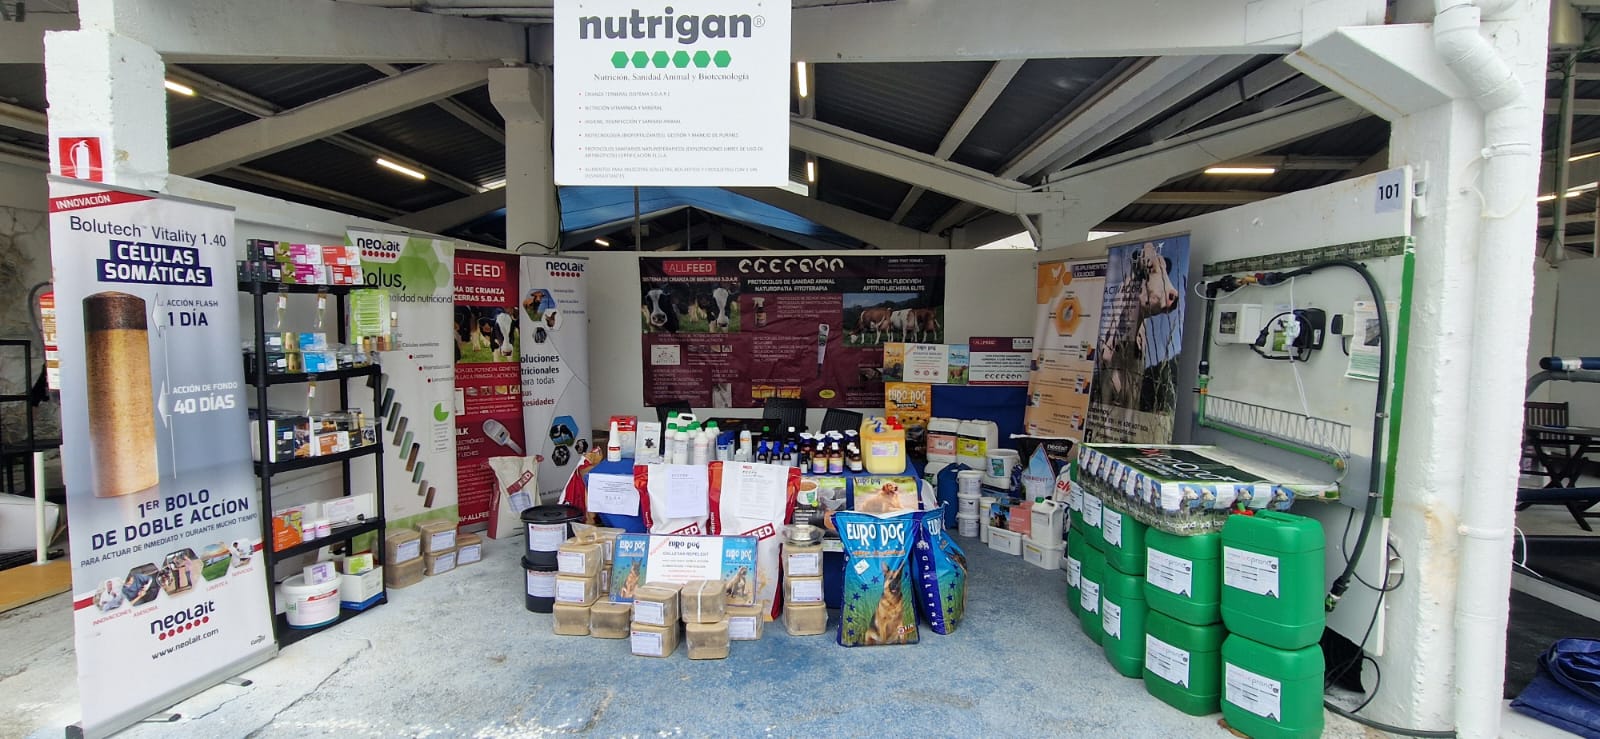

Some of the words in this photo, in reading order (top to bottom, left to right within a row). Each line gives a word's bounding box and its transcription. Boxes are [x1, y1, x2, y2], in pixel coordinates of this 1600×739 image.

[632, 73, 661, 81] Sanidad
[662, 73, 690, 81] Animal
[1379, 183, 1399, 200] 101
[56, 195, 111, 210] INNOVACIÓN
[152, 226, 197, 246] Vitality
[201, 233, 227, 247] 1.40
[357, 236, 401, 252] neolait
[117, 241, 194, 265] CÉLULAS
[105, 262, 207, 284] SOMÁTICAS
[454, 262, 503, 279] LFEED
[545, 260, 585, 272] neolait
[668, 263, 712, 273] ALLFEED
[465, 286, 475, 294] DE
[475, 287, 505, 296] CRIANZA
[167, 299, 194, 308] ACCIÓN
[195, 300, 219, 308] FLASH
[168, 311, 175, 327] 1
[180, 308, 209, 327] DÍA
[173, 383, 202, 395] ACCIÓN
[202, 383, 212, 392] DE
[213, 381, 238, 391] FONDO
[536, 376, 556, 385] todas
[174, 399, 196, 415] 40
[199, 393, 236, 413] DÍAS
[138, 499, 160, 518] 1ER
[165, 488, 210, 512] BOLO
[80, 557, 101, 568] PARA
[102, 546, 132, 562] ACTUAR
[133, 544, 143, 554] DE
[143, 533, 180, 551] INMEDIATO
[185, 525, 216, 539] DURANTE
[216, 517, 237, 531] MUCHO
[238, 512, 259, 525] TIEMPO
[91, 530, 118, 551] DE
[124, 513, 184, 542] DOBLE
[847, 522, 877, 547] EURO
[880, 522, 905, 547] DOG
[150, 600, 216, 635] neolait
[151, 627, 219, 660] www.neolait.com
